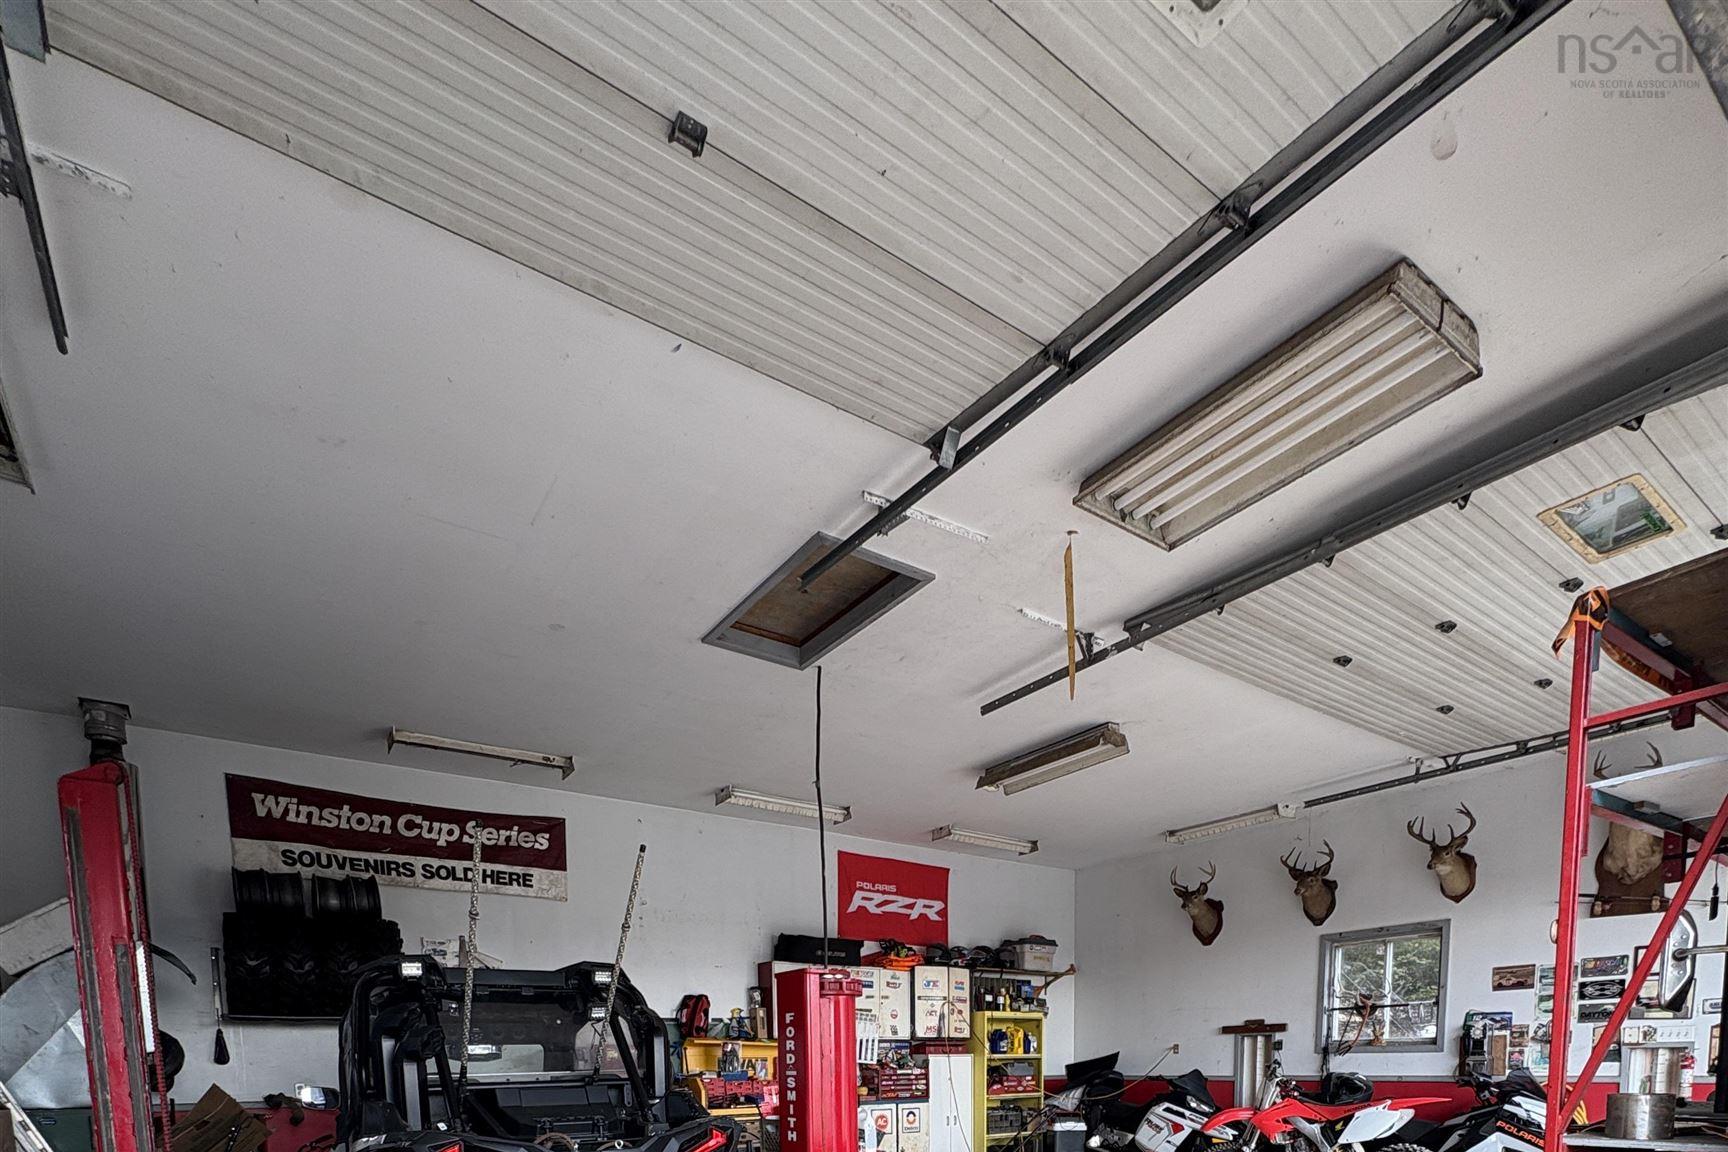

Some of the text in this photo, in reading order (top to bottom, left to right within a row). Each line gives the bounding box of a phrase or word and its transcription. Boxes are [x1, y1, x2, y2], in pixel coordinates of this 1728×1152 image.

[251, 792, 550, 850] Winston Cup Series
[280, 849, 534, 888] SOUVENIRS SOLD HERE
[856, 881, 897, 892] POLARIS
[846, 890, 946, 921] RZR
[1580, 1007, 1614, 1018] DAYTON
[876, 1118, 888, 1126] AC
[1496, 1120, 1545, 1148] POLARIS
